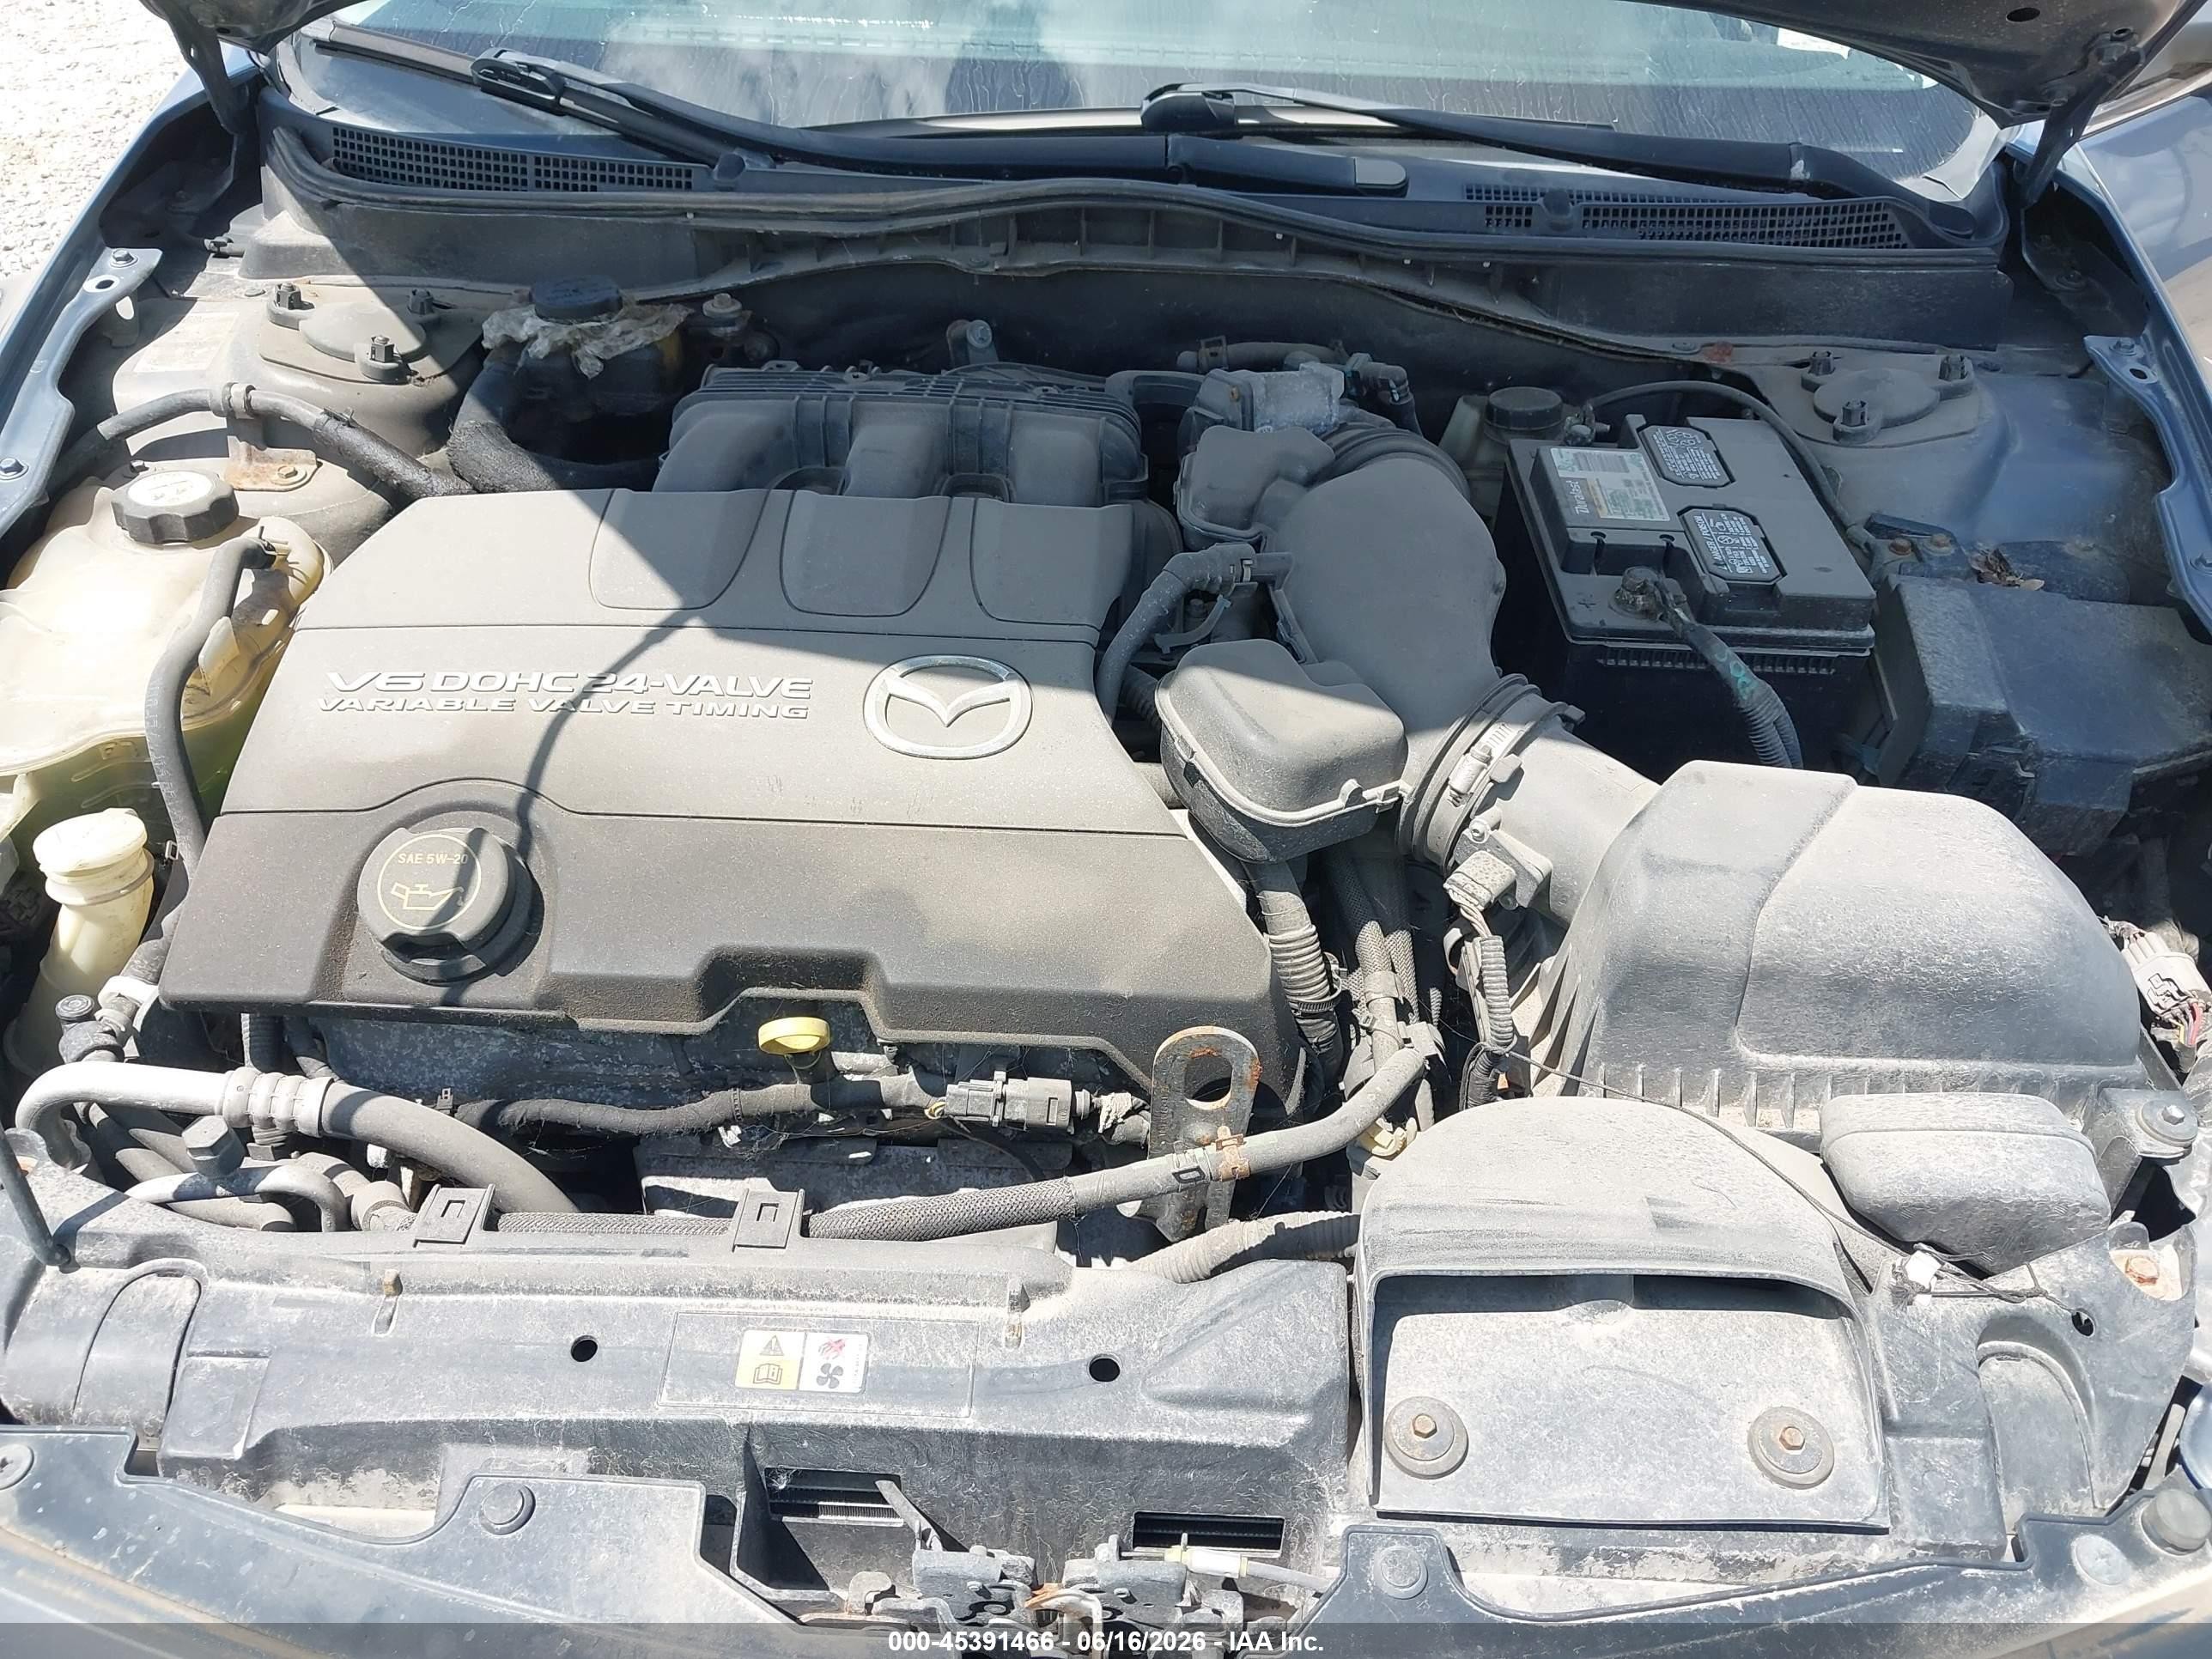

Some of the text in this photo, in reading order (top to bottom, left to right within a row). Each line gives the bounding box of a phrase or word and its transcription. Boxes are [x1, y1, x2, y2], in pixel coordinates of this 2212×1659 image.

[1693, 515, 1711, 537] POISON
[325, 671, 814, 700] V6 DOHC 24-VALVE
[317, 697, 811, 720] VARIABLE VALVE TIMING
[398, 853, 469, 866] SAE 5W-20
